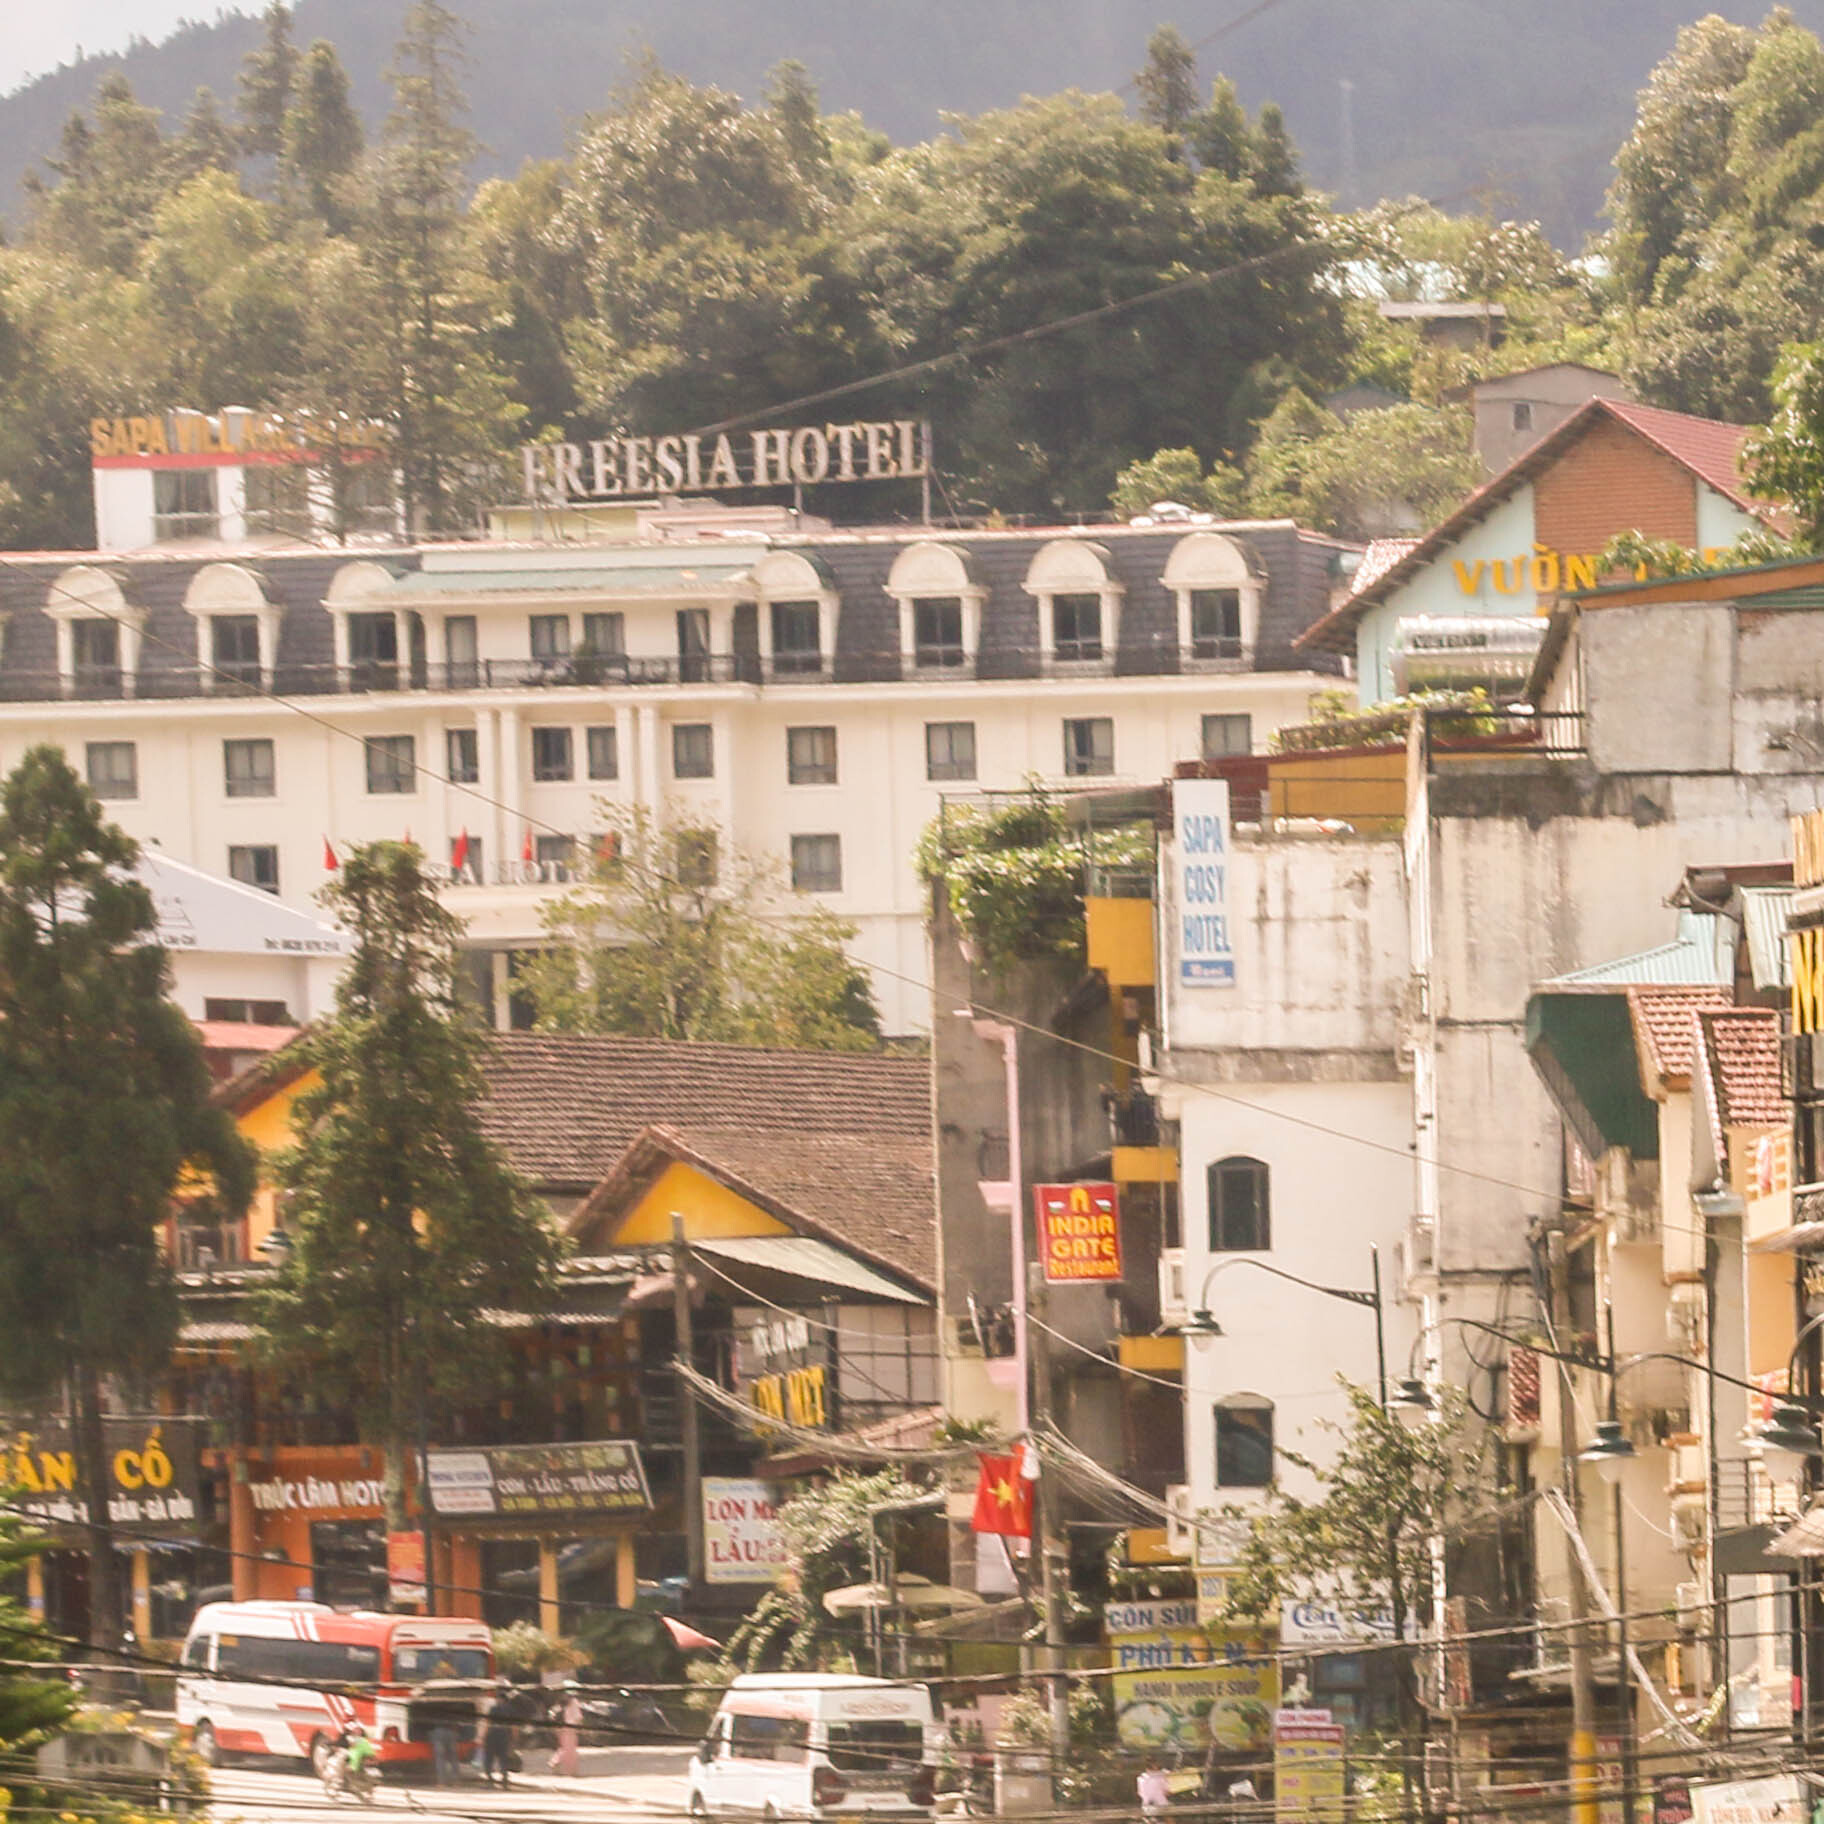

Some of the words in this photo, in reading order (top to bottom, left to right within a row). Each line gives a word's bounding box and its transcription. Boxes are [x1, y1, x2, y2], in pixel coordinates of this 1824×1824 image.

[521, 433, 742, 498] FREESIA
[750, 420, 928, 485] HOTEL
[1453, 543, 1598, 596] VƯỜN
[1183, 815, 1225, 854] SAPA
[1184, 864, 1225, 904] COSY
[1183, 914, 1231, 953] HOTEL
[1051, 1237, 1117, 1258] GATE
